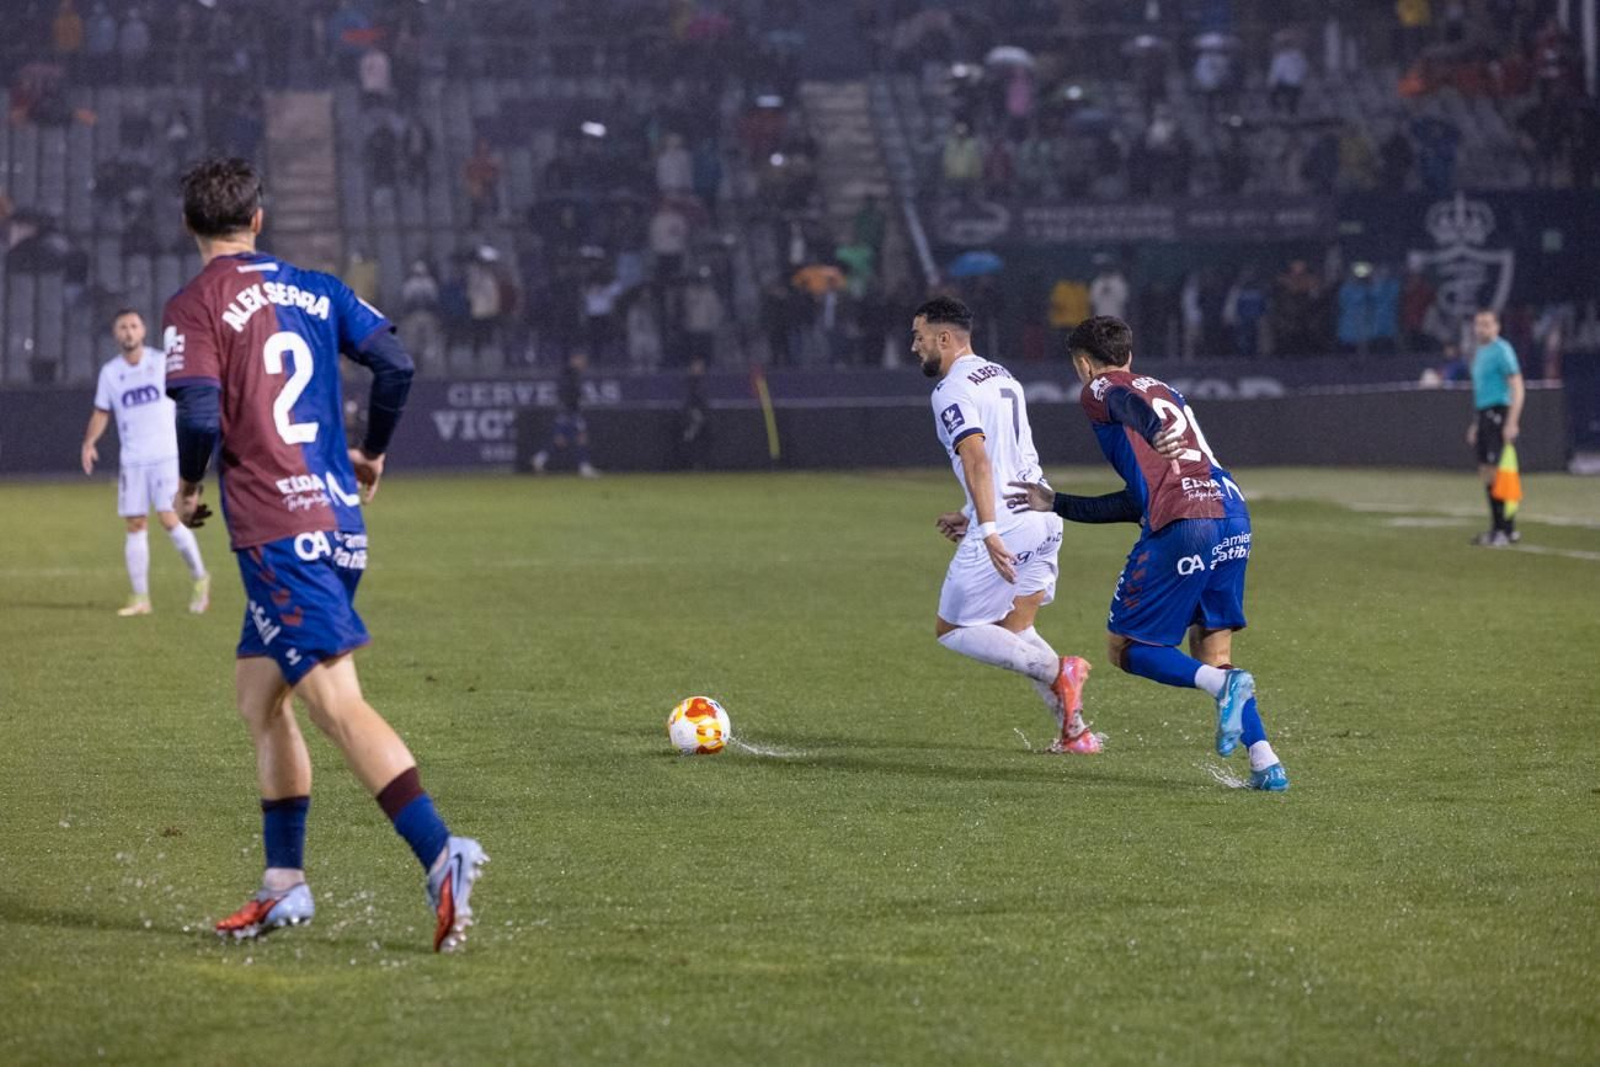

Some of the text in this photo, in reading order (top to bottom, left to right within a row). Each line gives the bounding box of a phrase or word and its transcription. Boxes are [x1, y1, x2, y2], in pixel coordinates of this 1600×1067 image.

[222, 281, 330, 333] ALEX SERRA
[263, 331, 319, 445] 2
[448, 381, 621, 406] CERVEAS
[1000, 388, 1020, 445] 7
